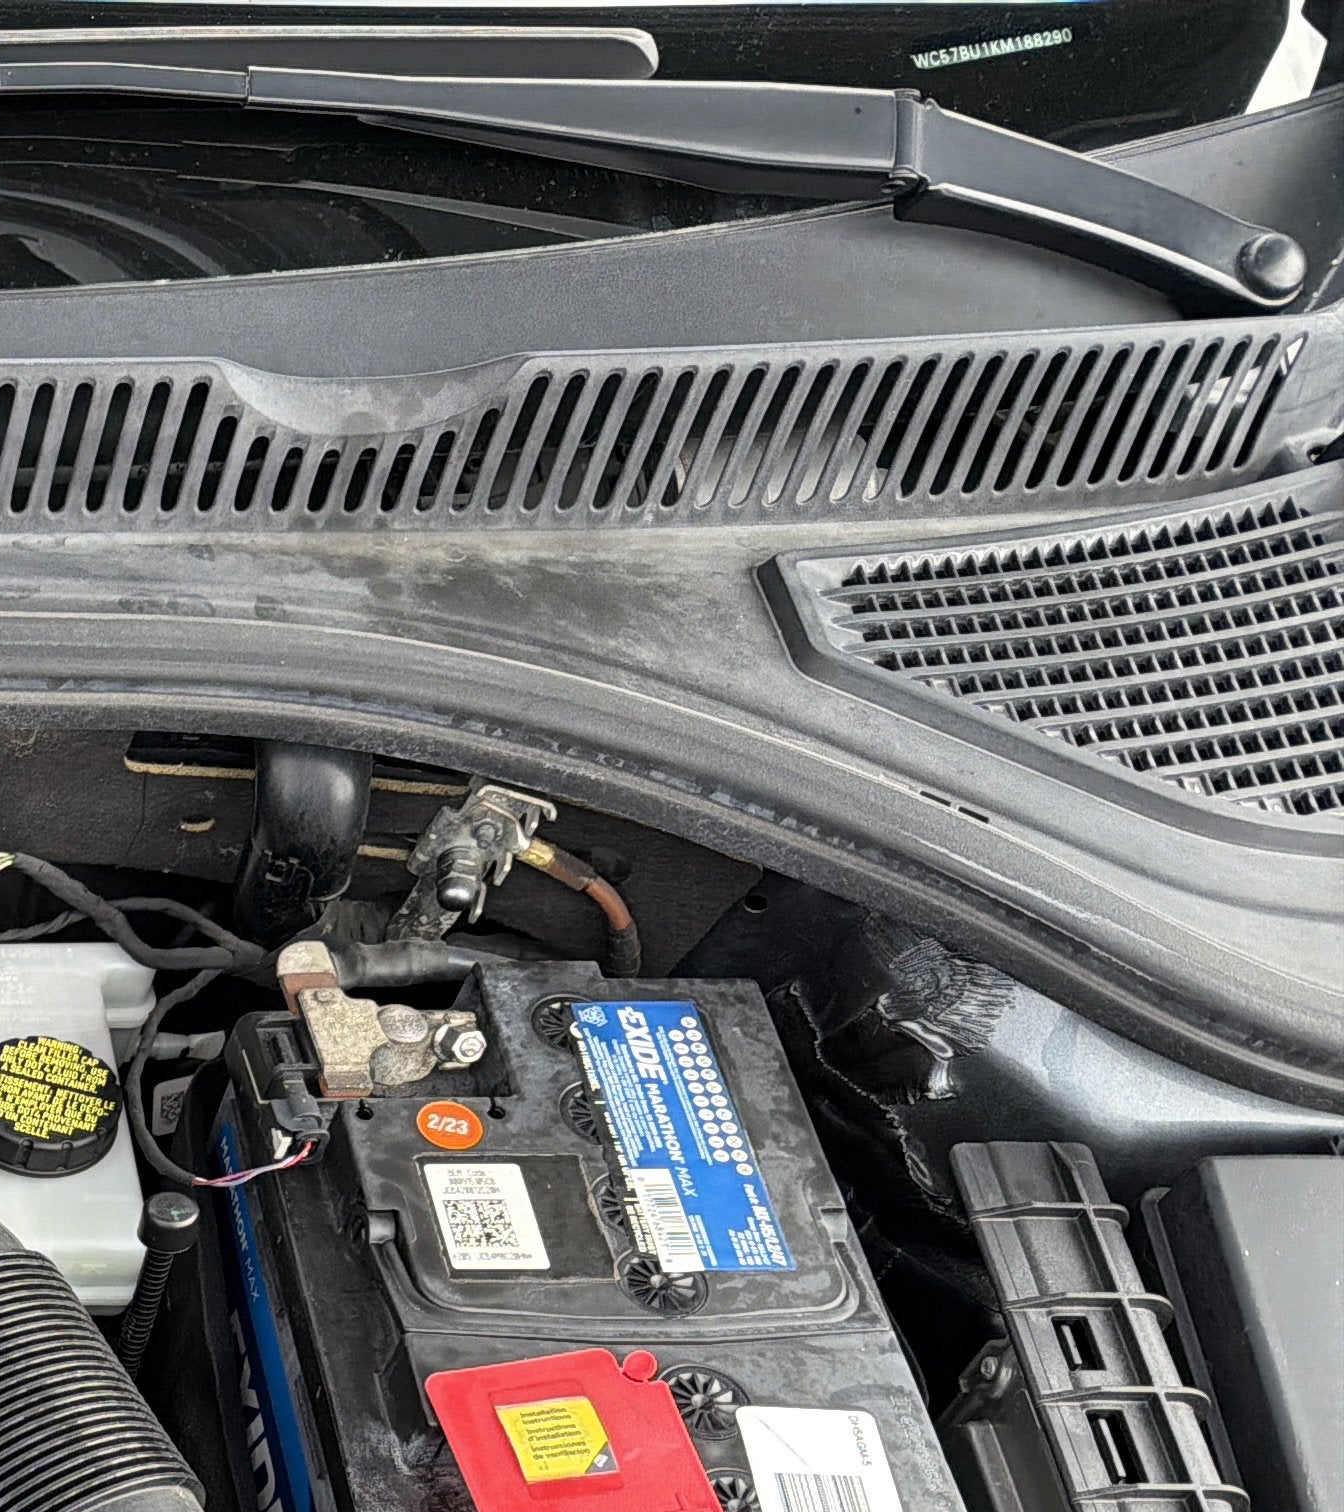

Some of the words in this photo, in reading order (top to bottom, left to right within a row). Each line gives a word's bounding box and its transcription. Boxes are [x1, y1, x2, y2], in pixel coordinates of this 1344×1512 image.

[2, 1045, 37, 1060] BEFORE
[90, 1066, 109, 1077] USE
[18, 1040, 46, 1054] CLEAN
[48, 1047, 79, 1062] FILLER
[80, 1055, 99, 1066] CAP
[0, 1054, 23, 1066] ONLY
[52, 1066, 78, 1080] FLUID
[80, 1073, 108, 1087] FROM
[10, 1066, 43, 1081] SEALED
[21, 1088, 51, 1103] AVANT
[56, 1088, 102, 1107] NETTOYER
[617, 1007, 666, 1080] EXIDE
[645, 1084, 683, 1160] MARATHON
[675, 1167, 698, 1198] MAX
[20, 1115, 74, 1135] CONTENANT
[42, 1111, 97, 1131] PROVENANT
[64, 1107, 81, 1118] QUE
[83, 1113, 98, 1123] DU
[427, 1113, 469, 1135] 2/23
[244, 1258, 260, 1303] MAX
